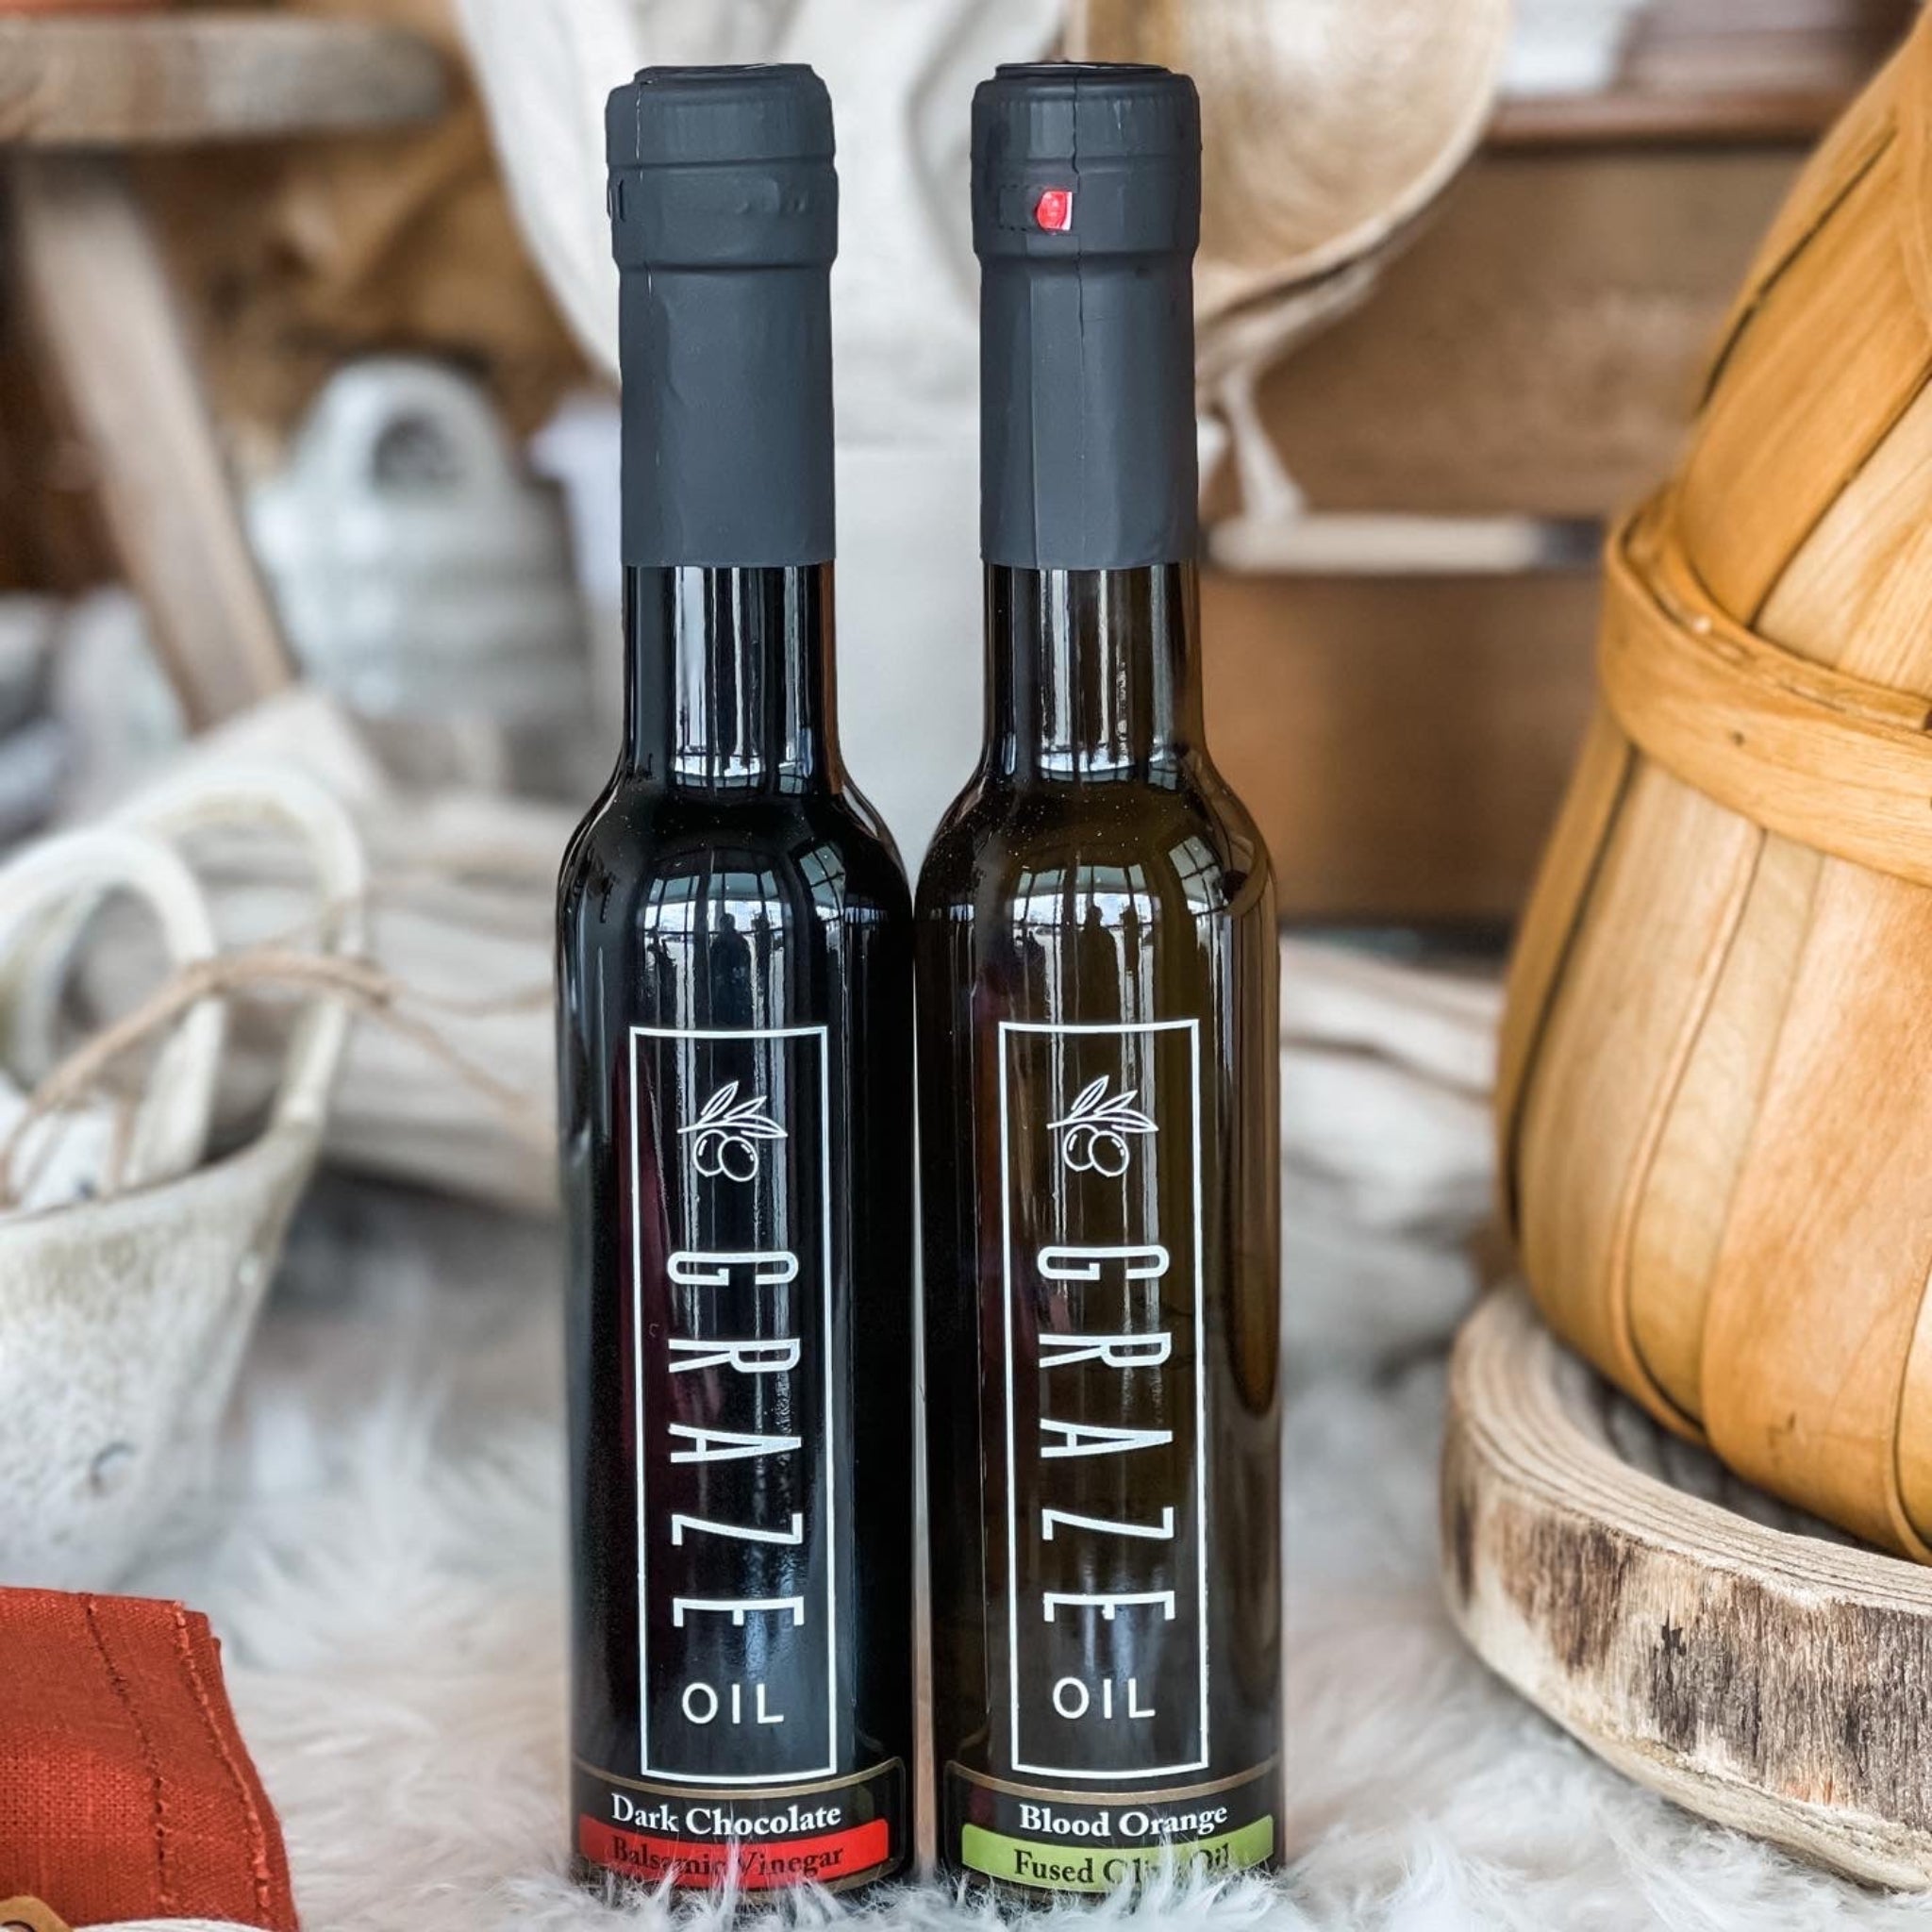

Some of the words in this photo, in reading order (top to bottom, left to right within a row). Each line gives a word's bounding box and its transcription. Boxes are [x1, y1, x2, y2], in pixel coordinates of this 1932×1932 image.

[666, 1250, 804, 1628] GRAZE
[1037, 1244, 1175, 1623] GRAZE
[681, 1682, 784, 1724] OIL
[1052, 1676, 1156, 1720] OIL
[611, 1792, 679, 1833] Dark
[686, 1805, 841, 1836] Chocolate
[1020, 1804, 1111, 1838] Blood
[1118, 1806, 1228, 1837] Orange
[1013, 1849, 1094, 1884] Fused
